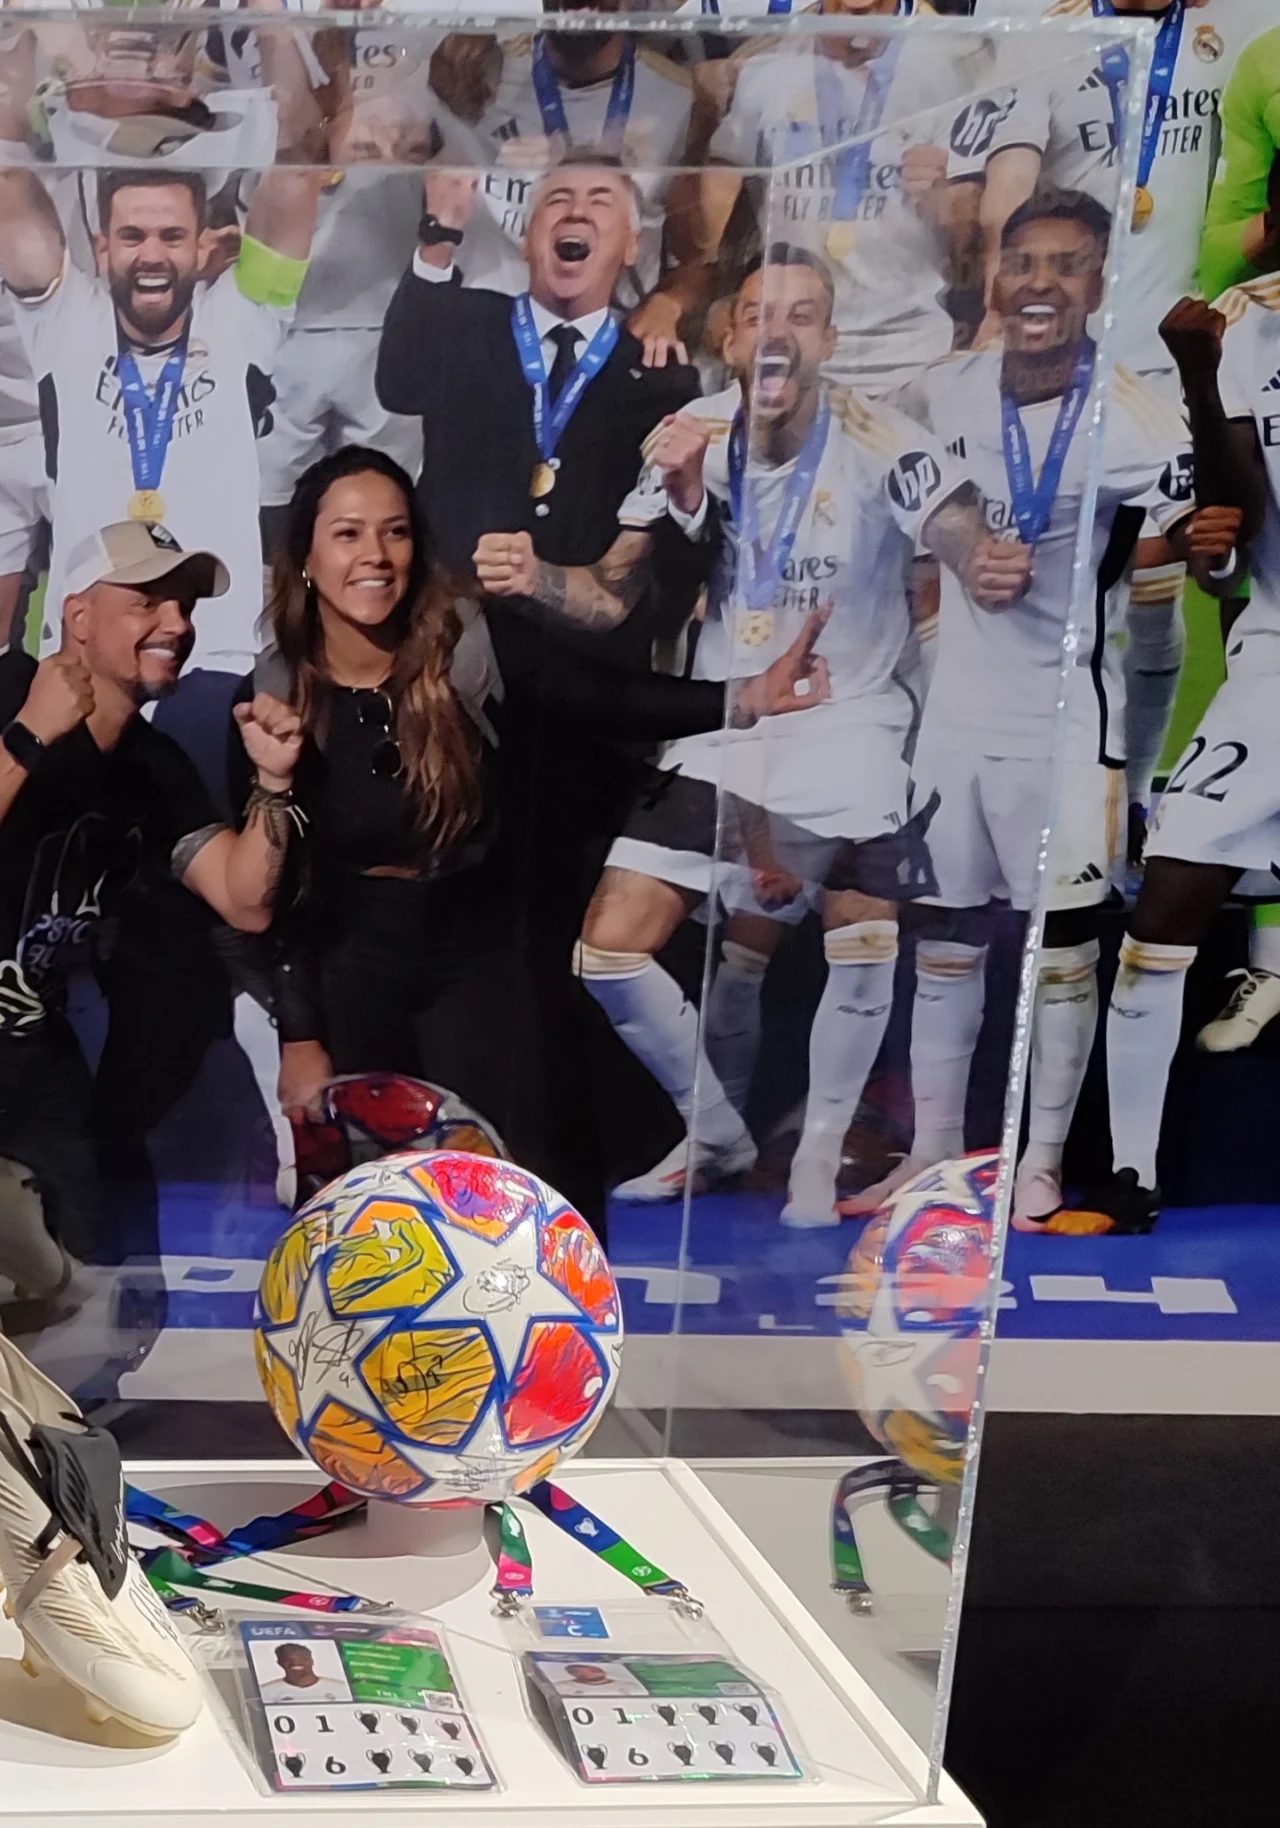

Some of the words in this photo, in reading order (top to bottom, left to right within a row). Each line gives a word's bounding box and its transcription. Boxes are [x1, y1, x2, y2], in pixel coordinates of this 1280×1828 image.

[894, 455, 938, 510] hp
[1164, 736, 1249, 803] 22
[250, 1626, 298, 1637] UEFA
[273, 1715, 296, 1735] 0
[314, 1714, 335, 1734] 1
[571, 1706, 595, 1726] 0
[611, 1707, 634, 1725] 1
[324, 1756, 347, 1775] 6
[627, 1747, 650, 1767] 6
